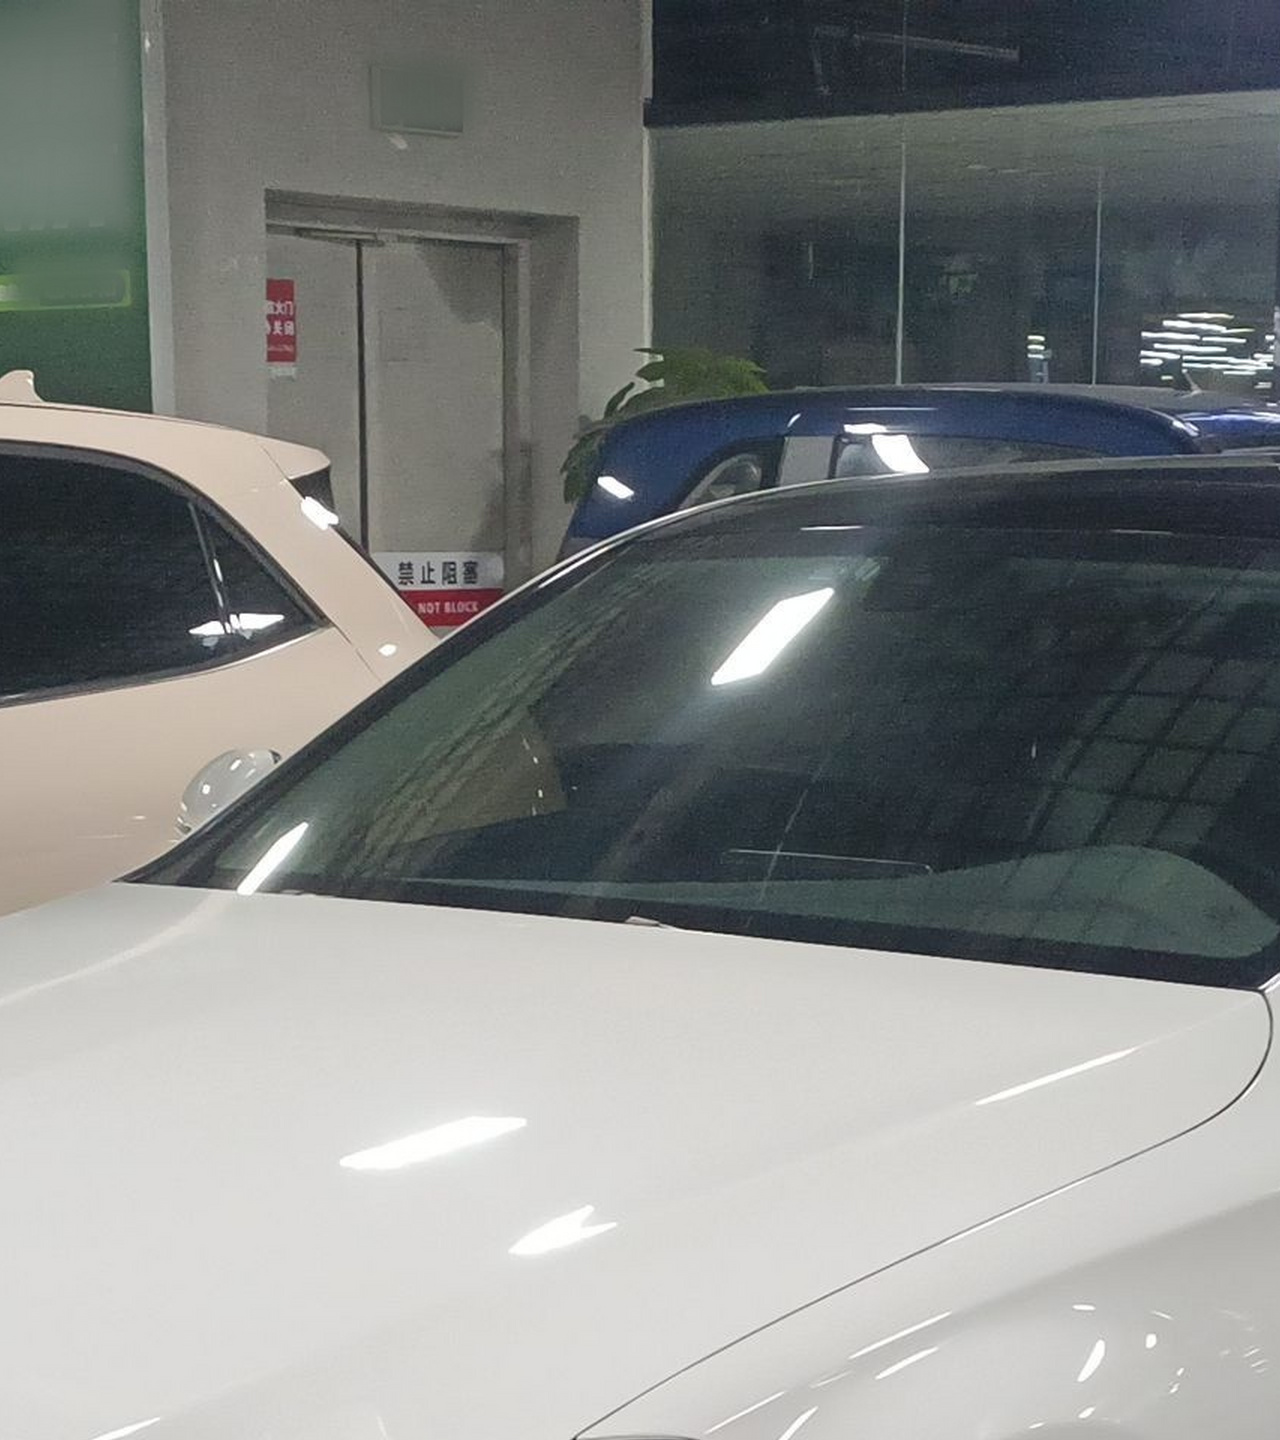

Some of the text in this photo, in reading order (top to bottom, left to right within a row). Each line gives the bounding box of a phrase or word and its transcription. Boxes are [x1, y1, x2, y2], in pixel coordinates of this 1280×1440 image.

[398, 561, 479, 585] 禁止阻塞
[418, 601, 479, 613] NOT BLOCK
